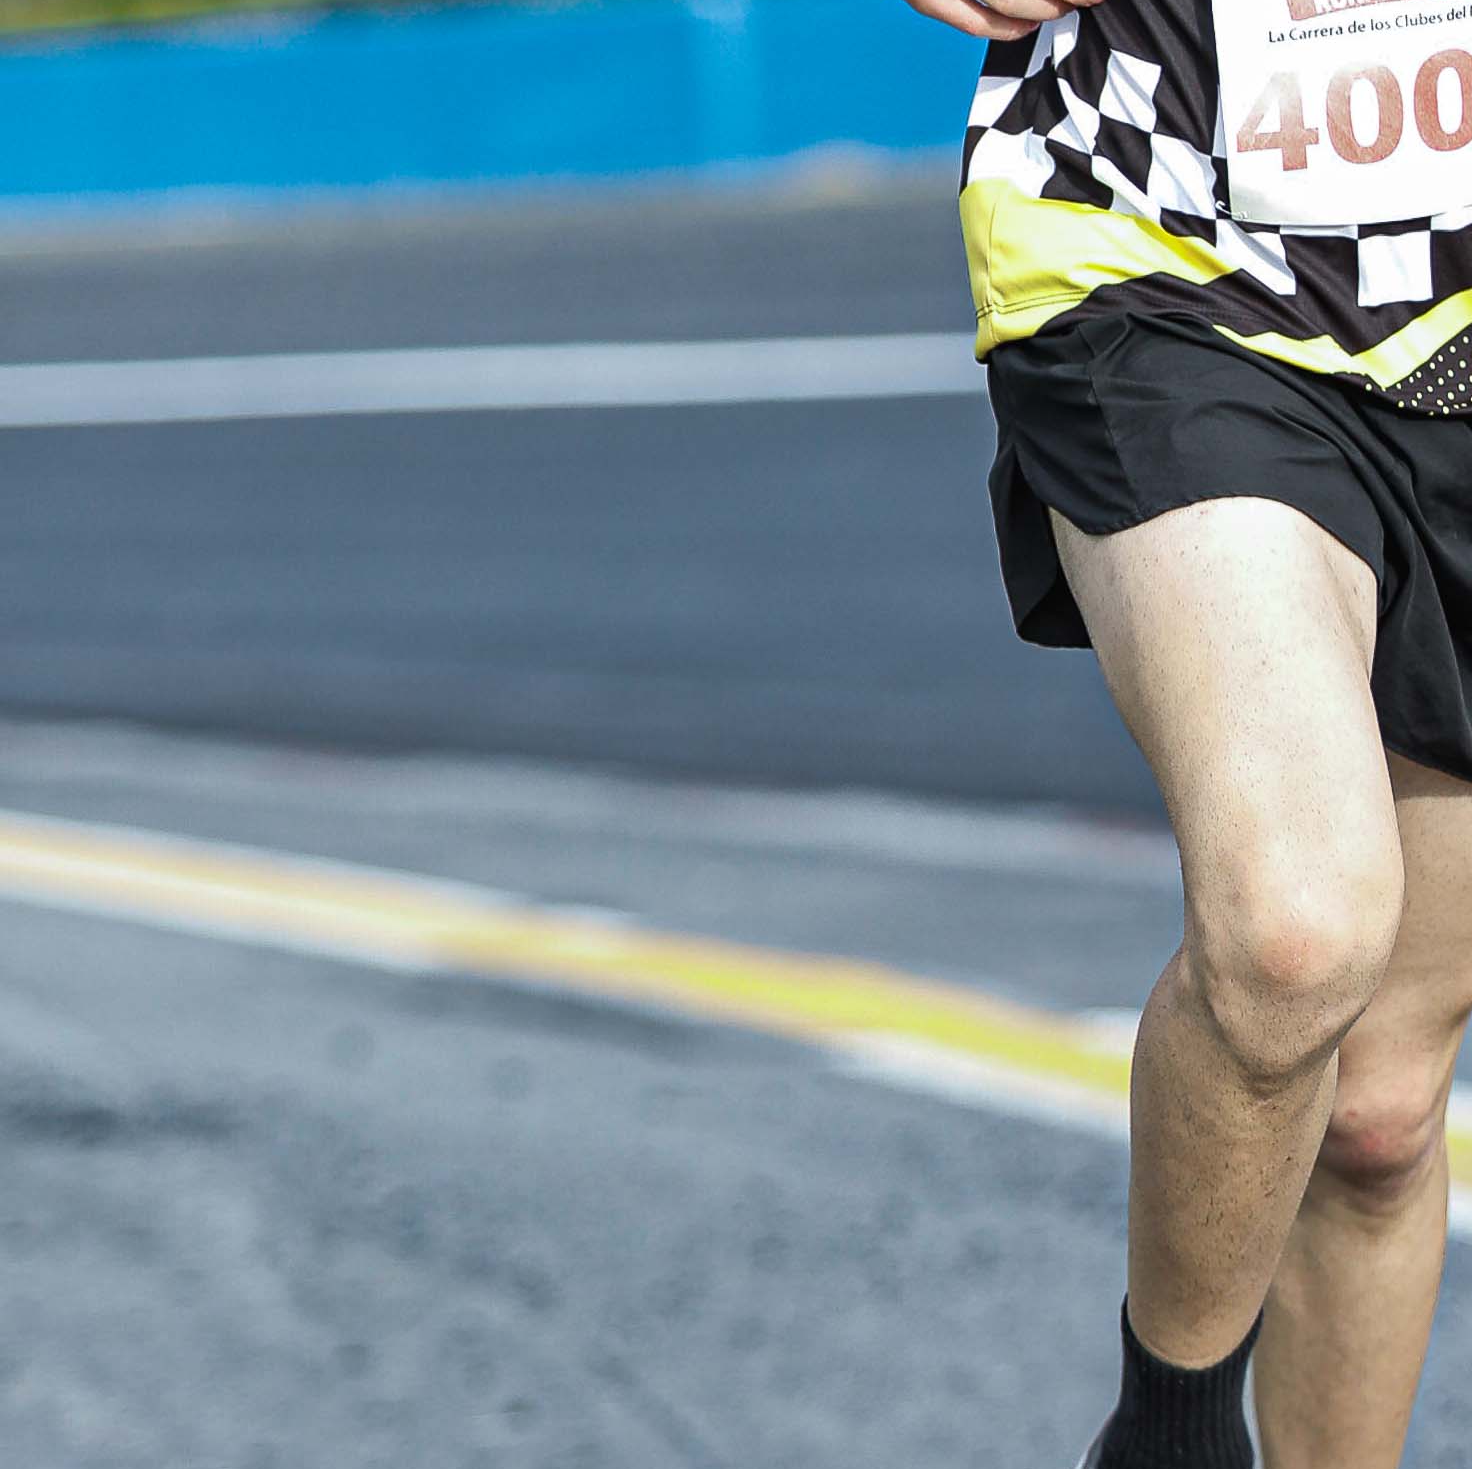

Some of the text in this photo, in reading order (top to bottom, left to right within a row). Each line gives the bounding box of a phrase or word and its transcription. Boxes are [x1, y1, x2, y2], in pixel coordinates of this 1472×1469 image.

[1268, 30, 1285, 44] La
[1289, 27, 1344, 42] Carrera
[1347, 20, 1367, 34] de
[1370, 19, 1392, 32] los
[1395, 12, 1444, 29] Clubes
[1446, 6, 1467, 22] del
